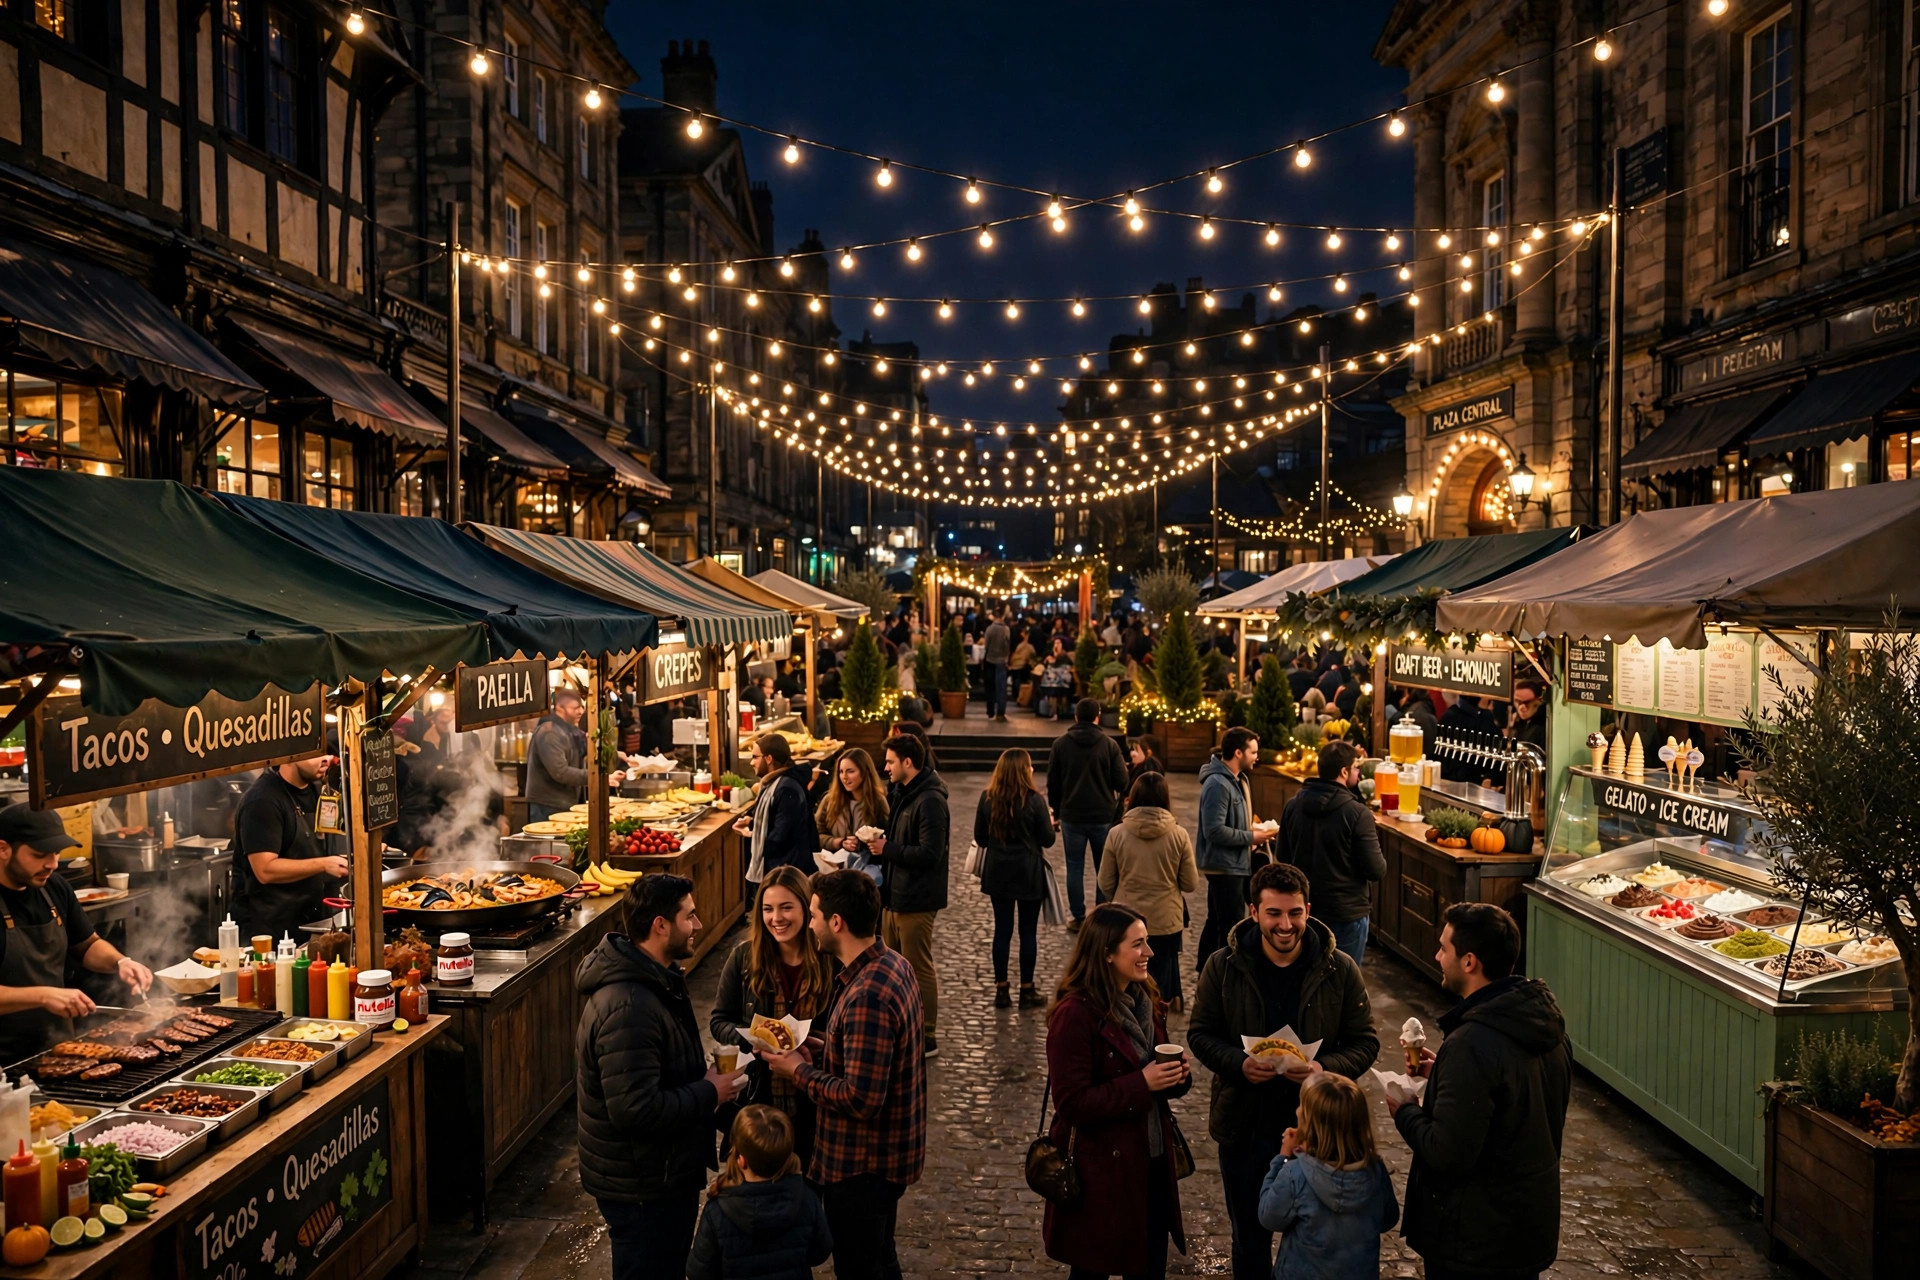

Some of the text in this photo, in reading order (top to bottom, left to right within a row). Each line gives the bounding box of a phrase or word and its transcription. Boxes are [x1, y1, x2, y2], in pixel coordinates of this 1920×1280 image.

[1433, 397, 1503, 431] PLAZA CENTRAL
[654, 650, 702, 689] CREPES
[1395, 653, 1502, 687] CRAFT BEER LEMONADE
[477, 670, 534, 710] PAELLA
[60, 695, 312, 773] Tacos Quesadillas
[1605, 785, 1729, 837] GELATO ICE CREAM
[194, 1104, 380, 1270] Tacos Quesadillas
